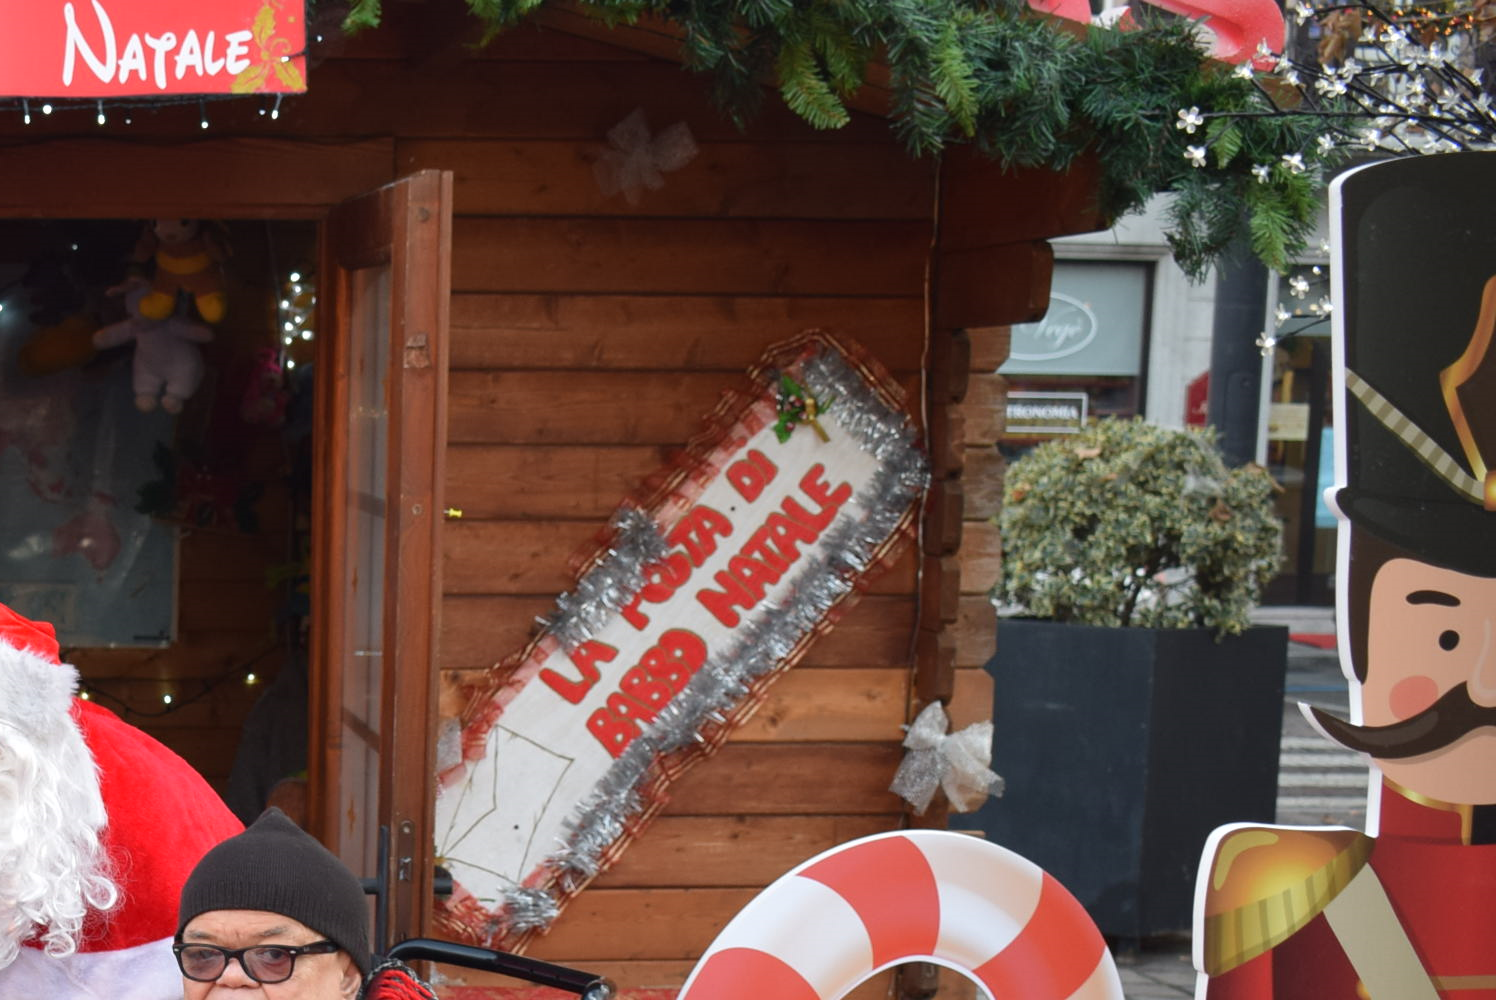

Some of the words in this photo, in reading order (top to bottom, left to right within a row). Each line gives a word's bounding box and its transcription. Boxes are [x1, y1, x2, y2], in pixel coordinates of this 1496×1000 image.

[539, 639, 619, 705] LA
[726, 449, 779, 504] DI
[586, 628, 708, 759] BABBO
[696, 463, 853, 628] NATALE
